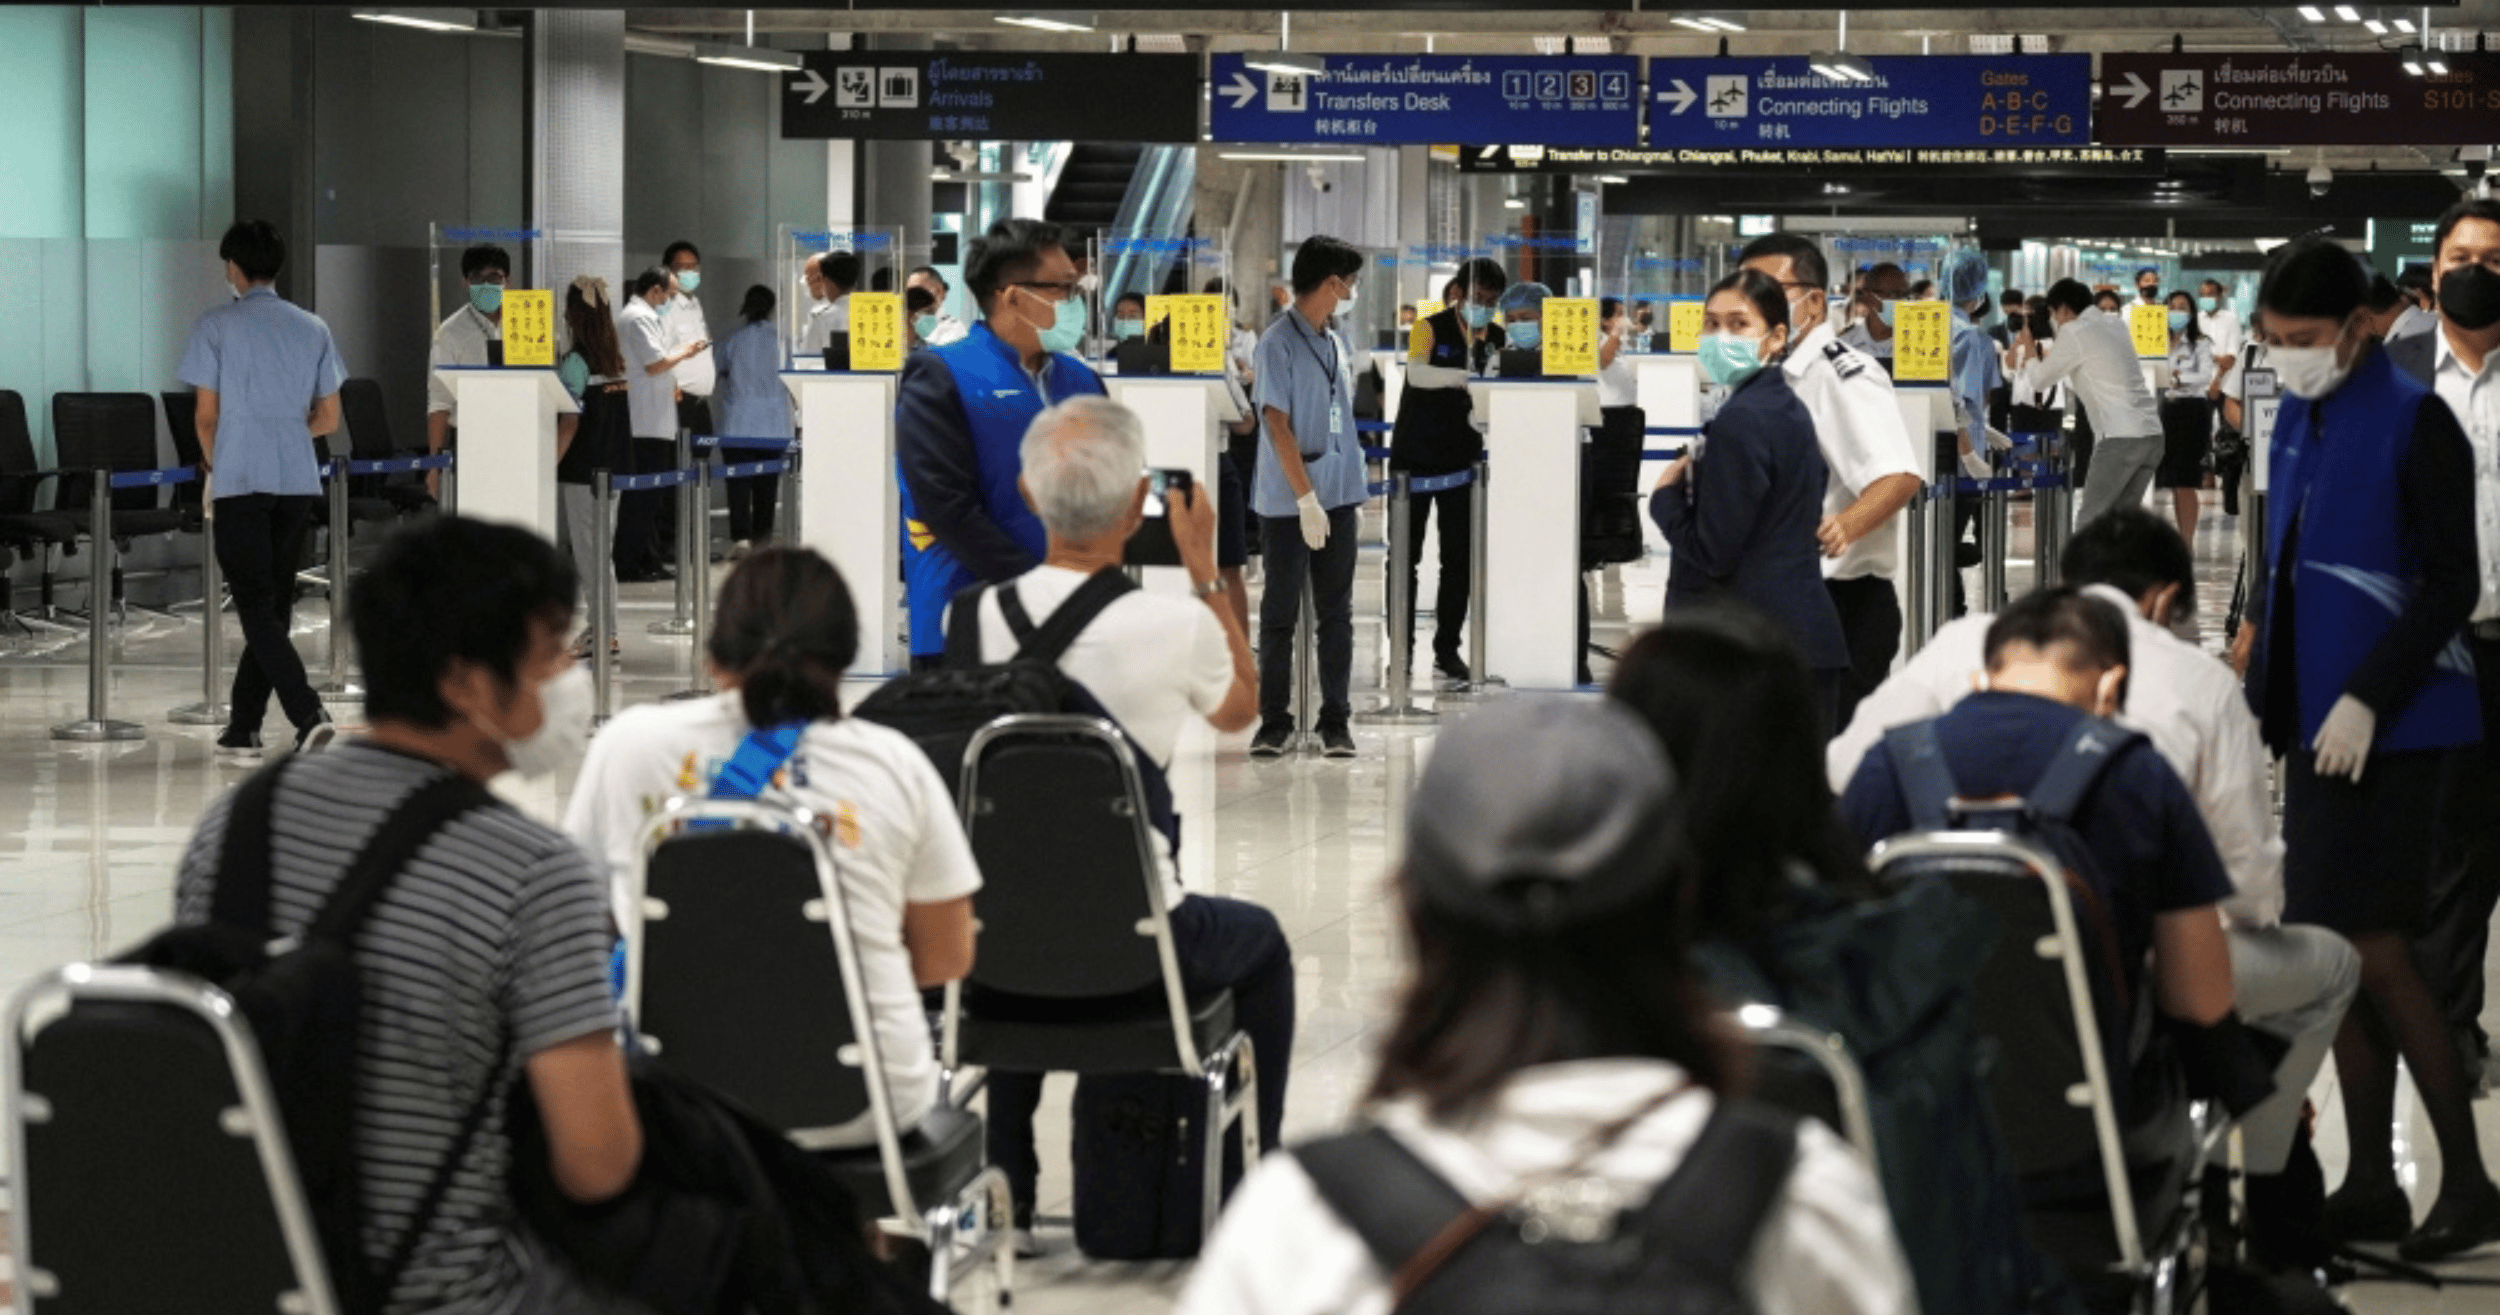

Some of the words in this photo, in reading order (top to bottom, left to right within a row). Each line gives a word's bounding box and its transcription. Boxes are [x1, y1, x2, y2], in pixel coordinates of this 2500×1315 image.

[1511, 77, 1521, 94] 1
[1542, 77, 1556, 95] 2
[1574, 77, 1589, 95] 3
[1606, 77, 1621, 95] 4
[1982, 70, 2029, 86] Gates
[927, 90, 994, 107] Arrivals
[1315, 92, 1399, 110] Transfers
[1404, 92, 1451, 110] Desk
[1758, 97, 1862, 118] Connecting
[1867, 97, 1929, 118] Flights
[2214, 91, 2321, 113] Connecting
[2328, 91, 2390, 113] Flights
[1548, 149, 1594, 161] Transfer
[1597, 149, 1608, 161] to
